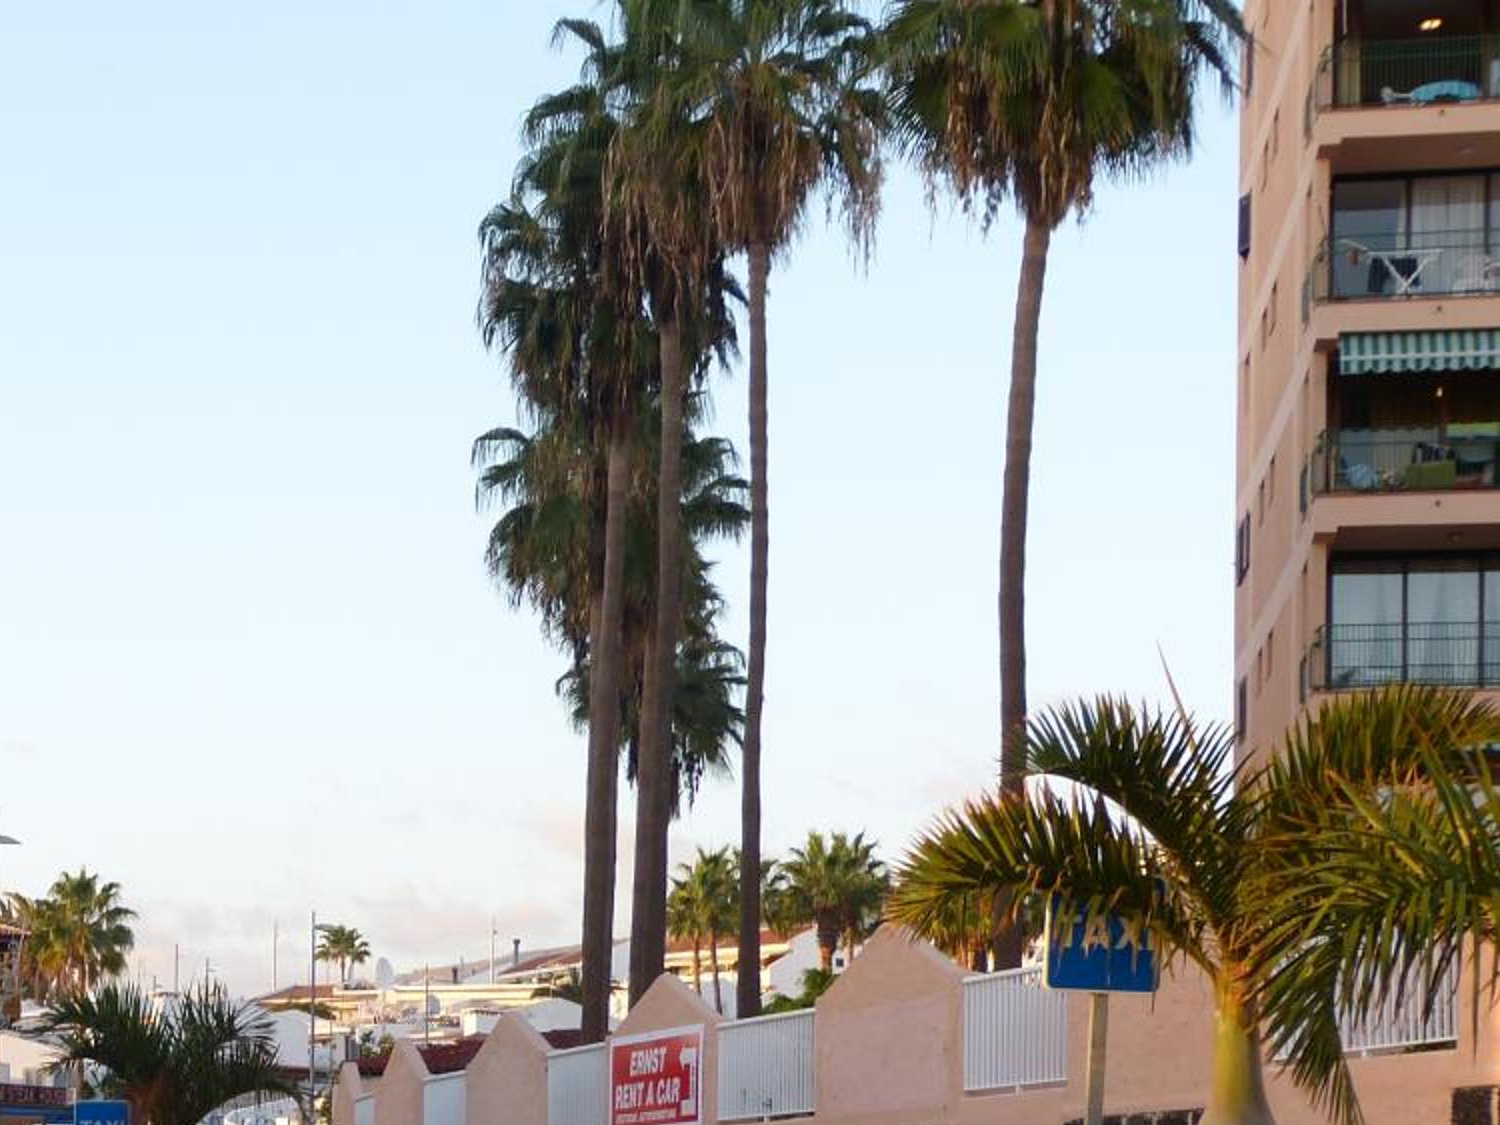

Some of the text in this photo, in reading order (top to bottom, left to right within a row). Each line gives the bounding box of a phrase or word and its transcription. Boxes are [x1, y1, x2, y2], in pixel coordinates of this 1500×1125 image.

[629, 1047, 667, 1076] ERNST
[615, 1076, 681, 1110] RENT A CAR
